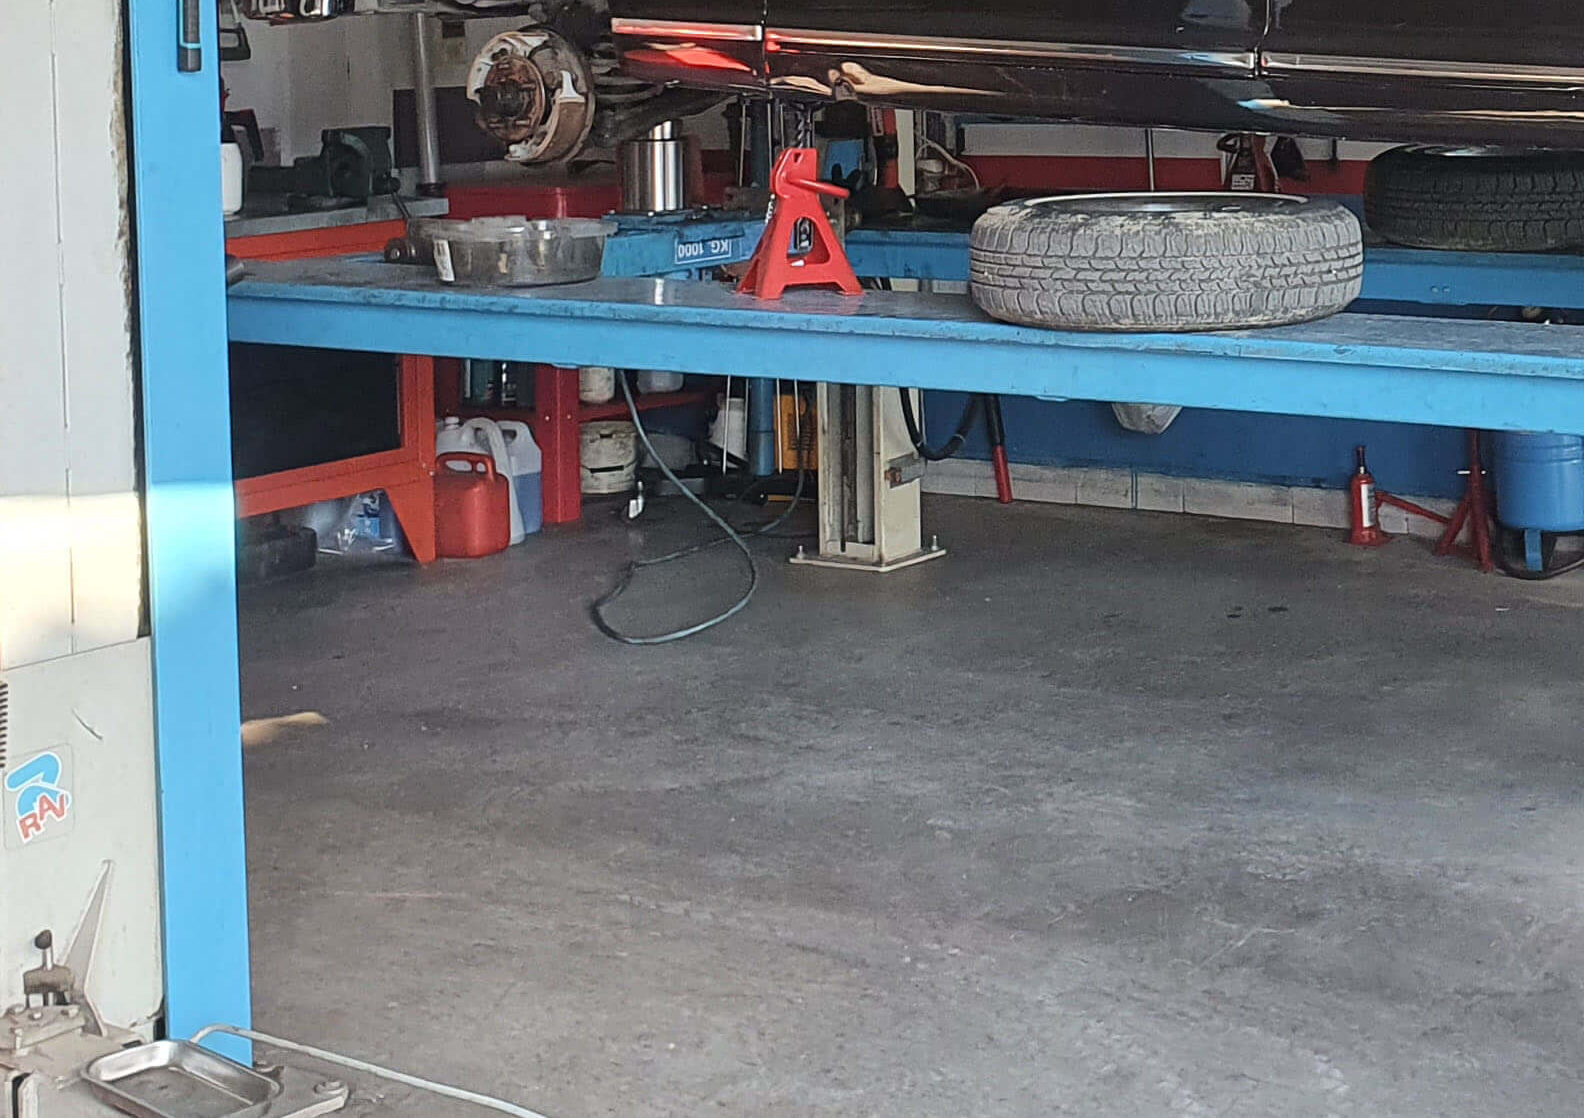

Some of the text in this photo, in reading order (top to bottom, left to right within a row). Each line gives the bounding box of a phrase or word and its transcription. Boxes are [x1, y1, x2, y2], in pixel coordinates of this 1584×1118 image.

[678, 239, 729, 258] KG 1000
[18, 792, 66, 840] RAV
